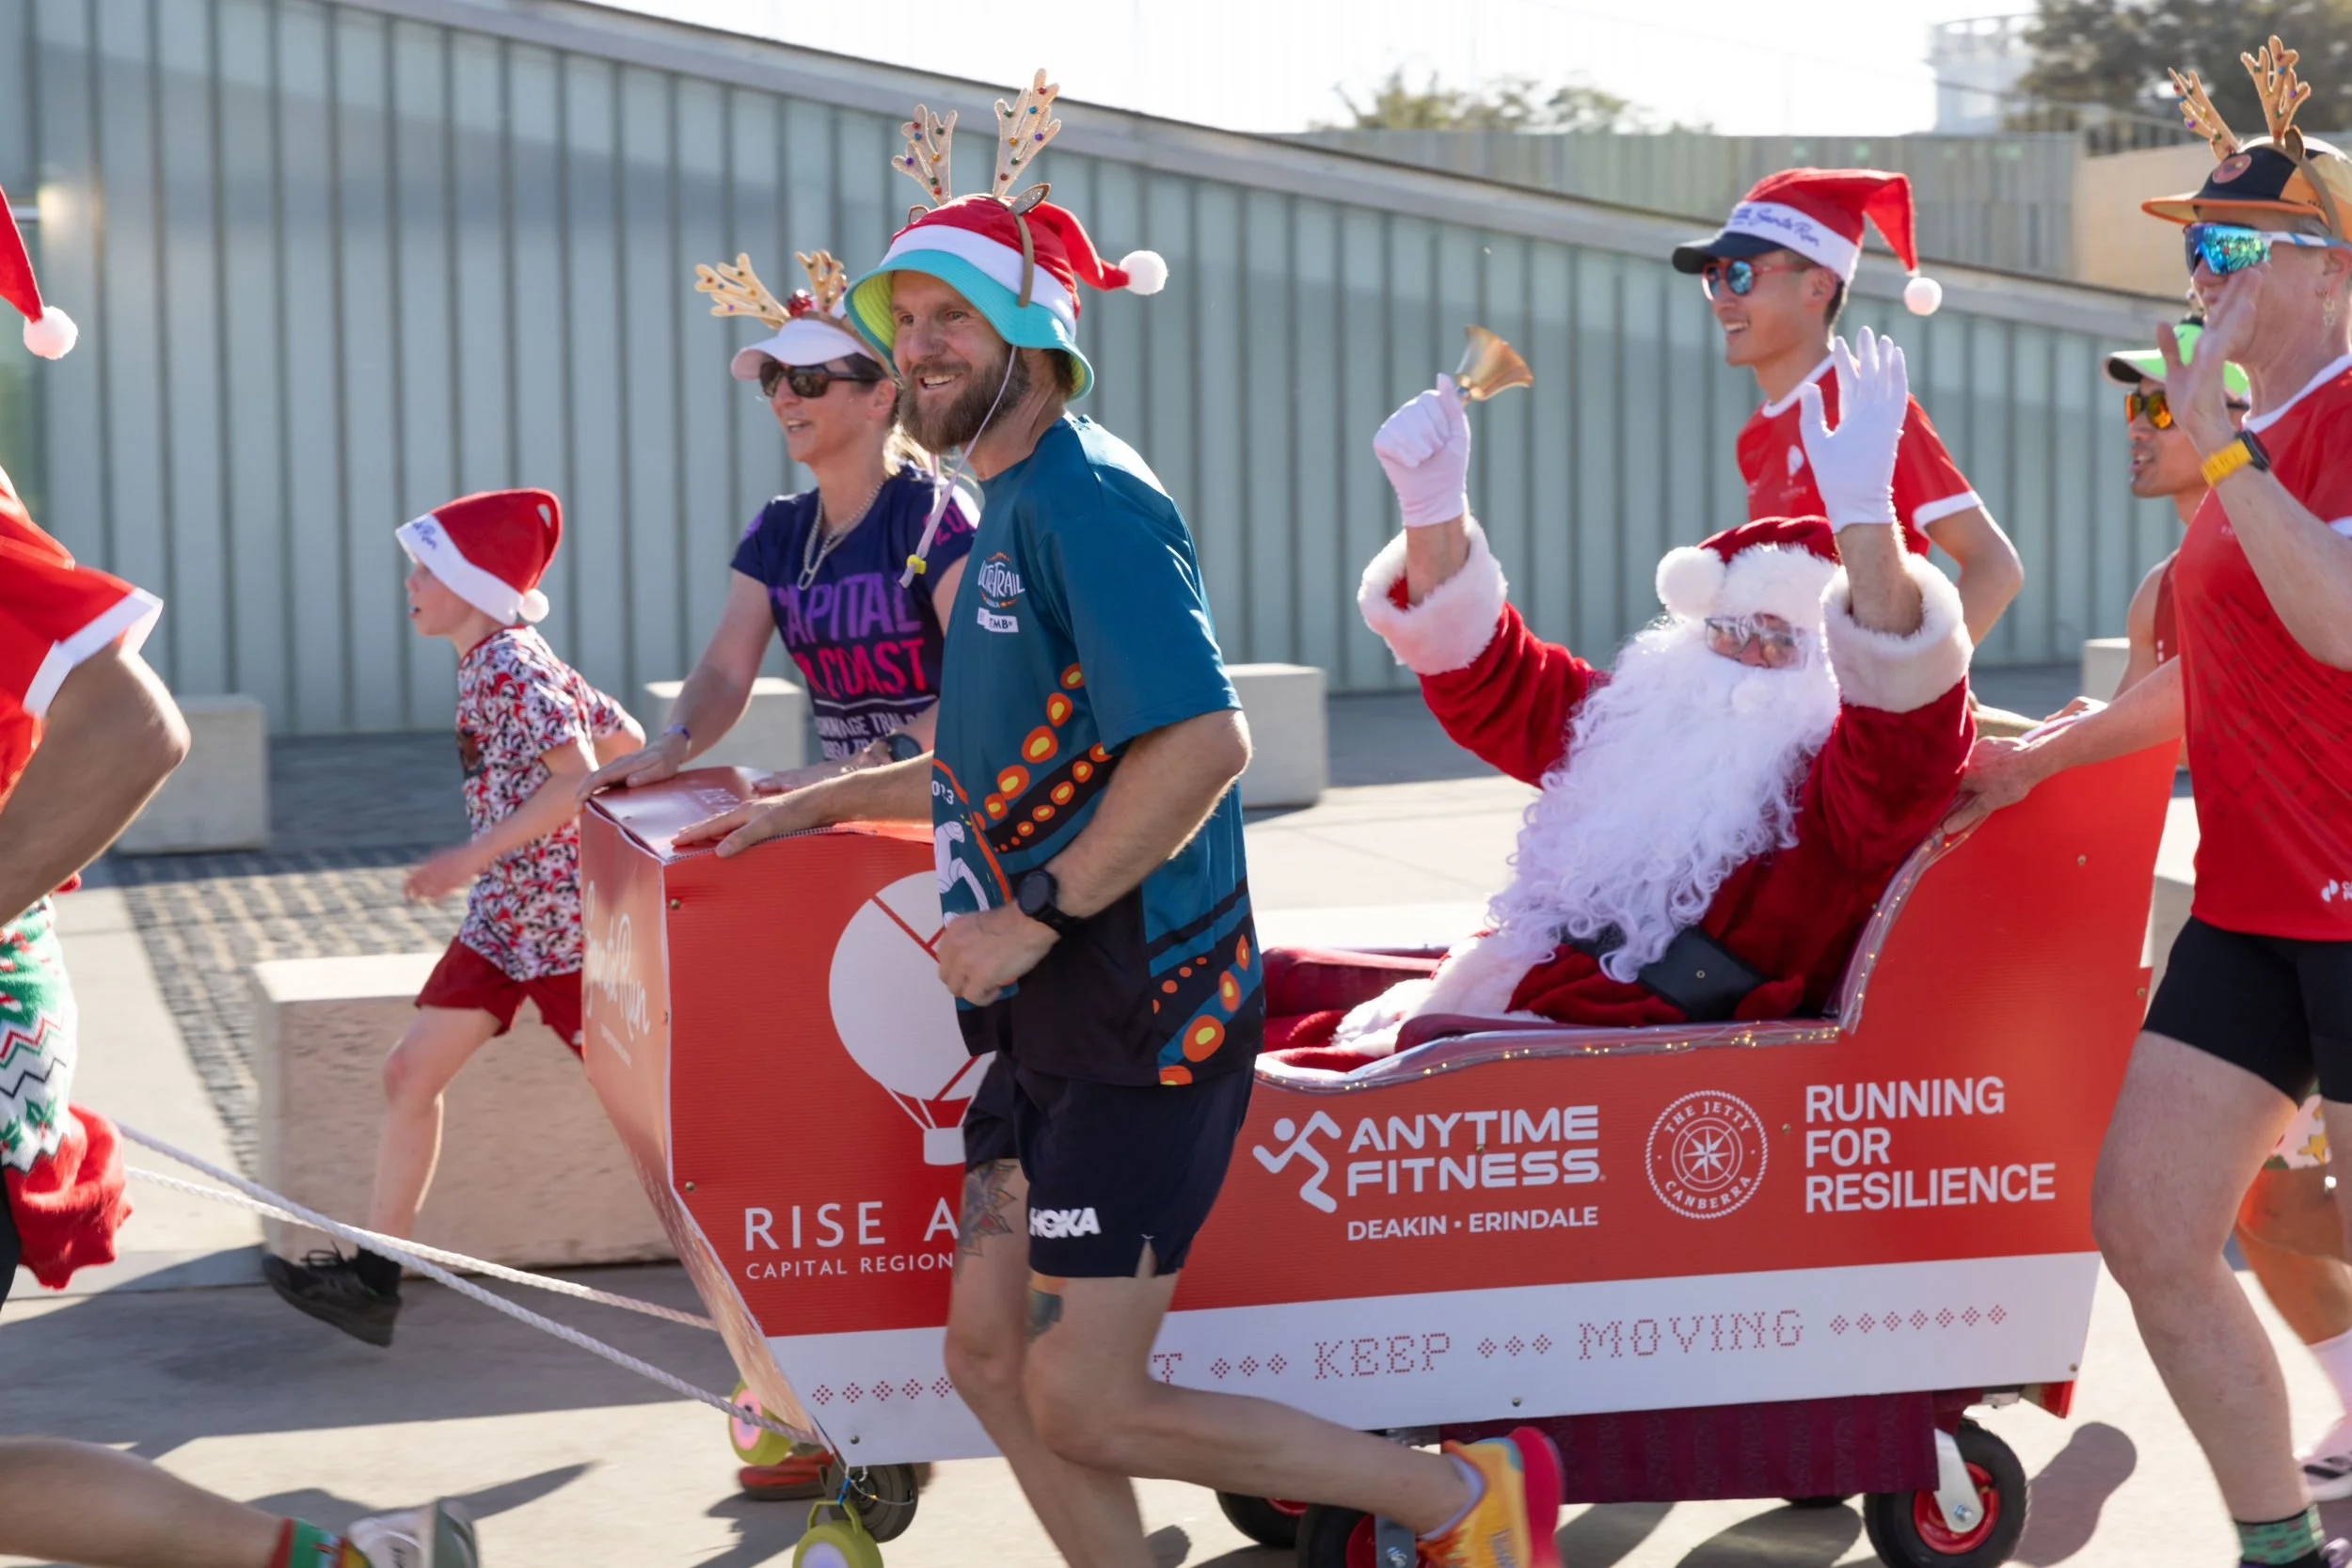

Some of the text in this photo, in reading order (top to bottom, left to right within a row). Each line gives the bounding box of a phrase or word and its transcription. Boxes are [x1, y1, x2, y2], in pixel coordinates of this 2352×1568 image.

[817, 637, 926, 700] COAST
[1663, 1101, 1752, 1133] THE JETTY
[1805, 1075, 2006, 1123] RUNNING
[1347, 1104, 1598, 1153] ANYTIME
[1805, 1126, 1892, 1168] FOR
[1347, 1148, 1599, 1196] FITNESS
[1664, 1176, 1752, 1210] CANBERRA
[1805, 1162, 2056, 1213] RESILIENCE
[744, 1200, 886, 1251] RISE
[1029, 1207, 1102, 1239] HOKA
[1347, 1206, 1599, 1241] DEAKIN ERINDALE
[745, 1252, 954, 1280] CAPITAL REGION
[1314, 1332, 1451, 1380] KEEP
[1579, 1309, 1804, 1360] MOVING
